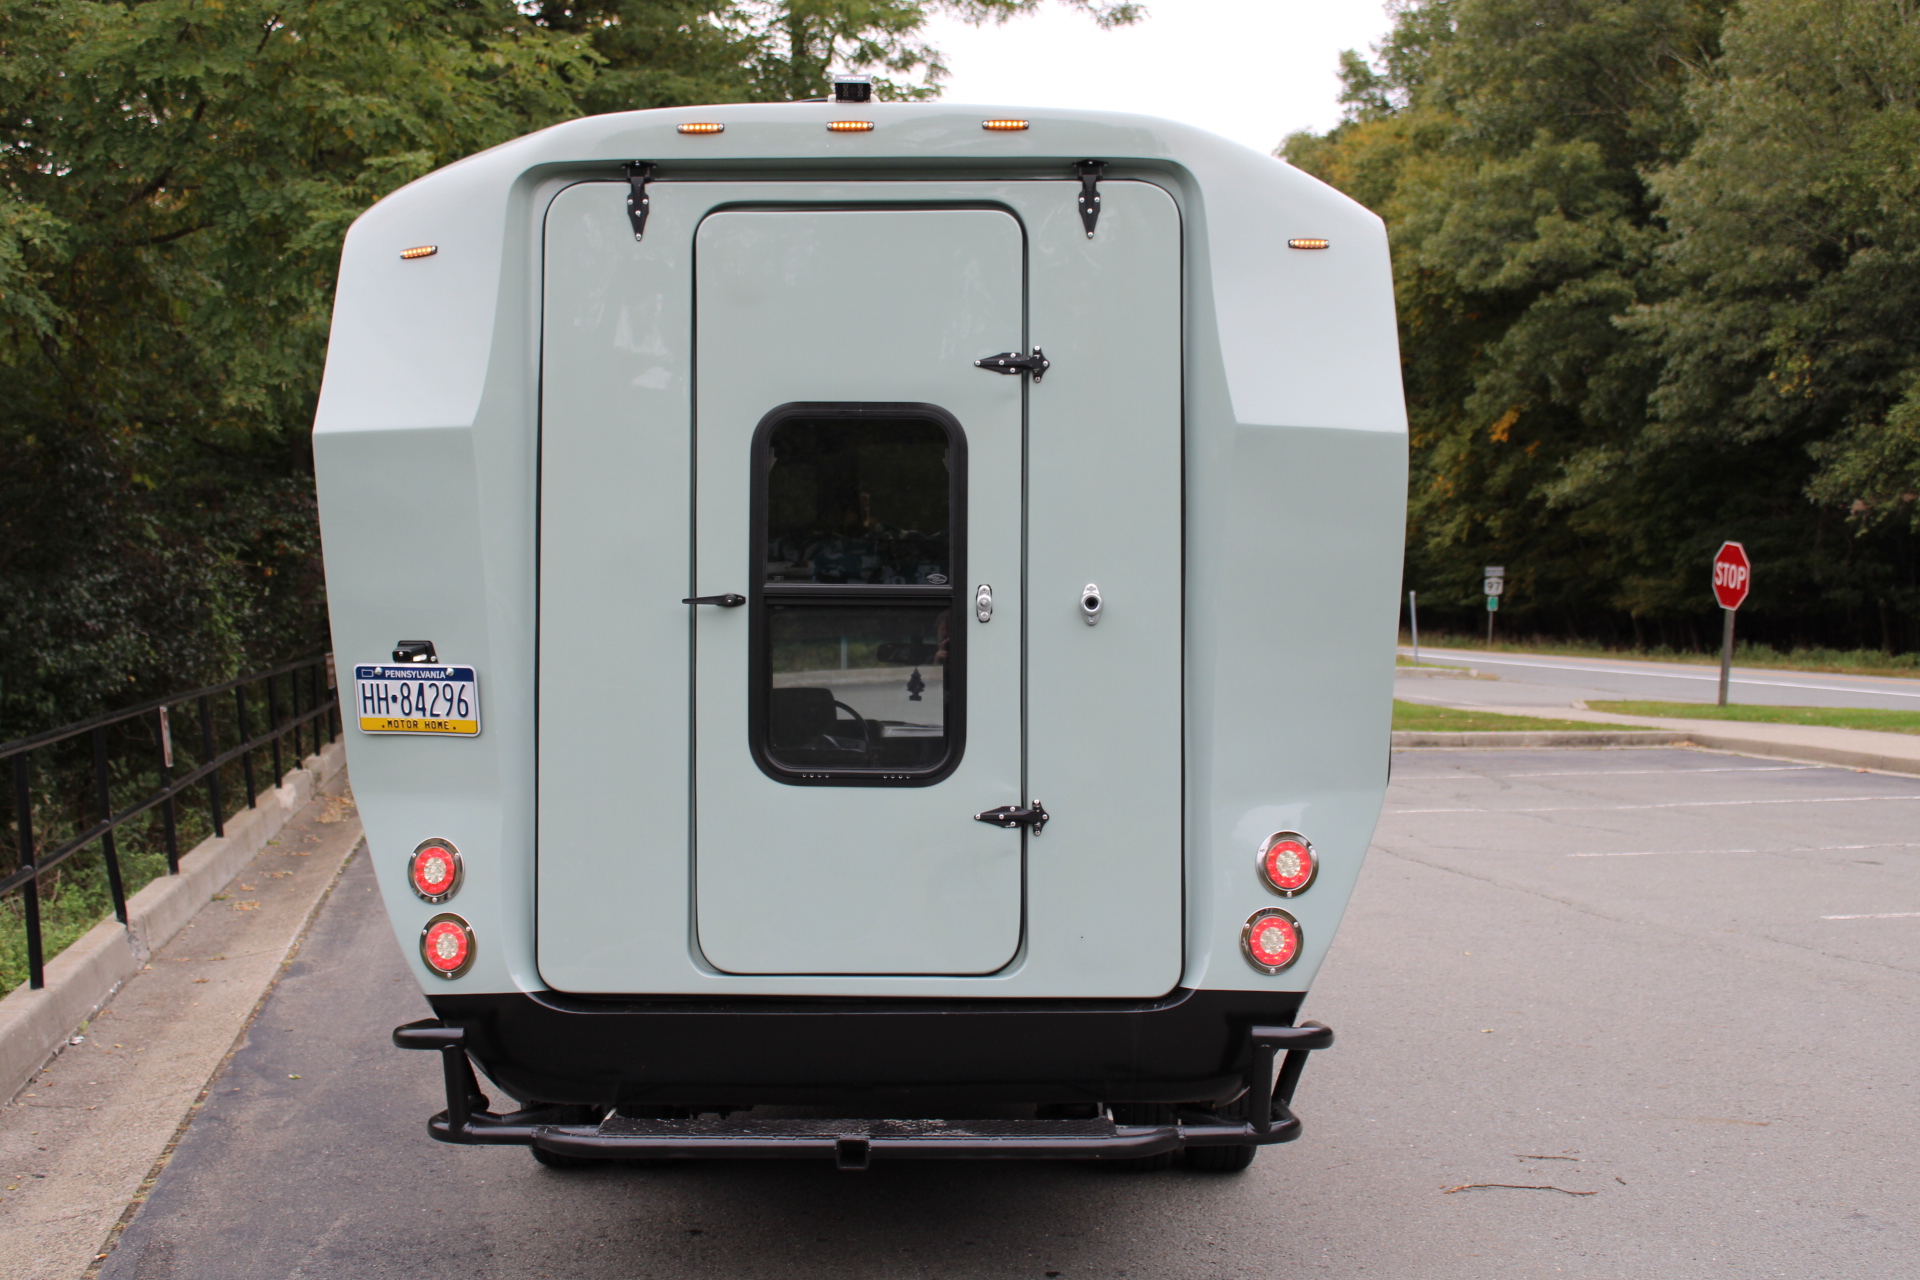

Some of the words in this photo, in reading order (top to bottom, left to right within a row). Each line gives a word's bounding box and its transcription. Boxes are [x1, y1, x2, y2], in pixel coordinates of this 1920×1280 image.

[1715, 562, 1747, 590] STOP
[1486, 581, 1501, 592] 97
[385, 669, 446, 679] PENNSYLVANIA
[387, 720, 419, 730] MOTOR
[424, 721, 450, 730] HOME
